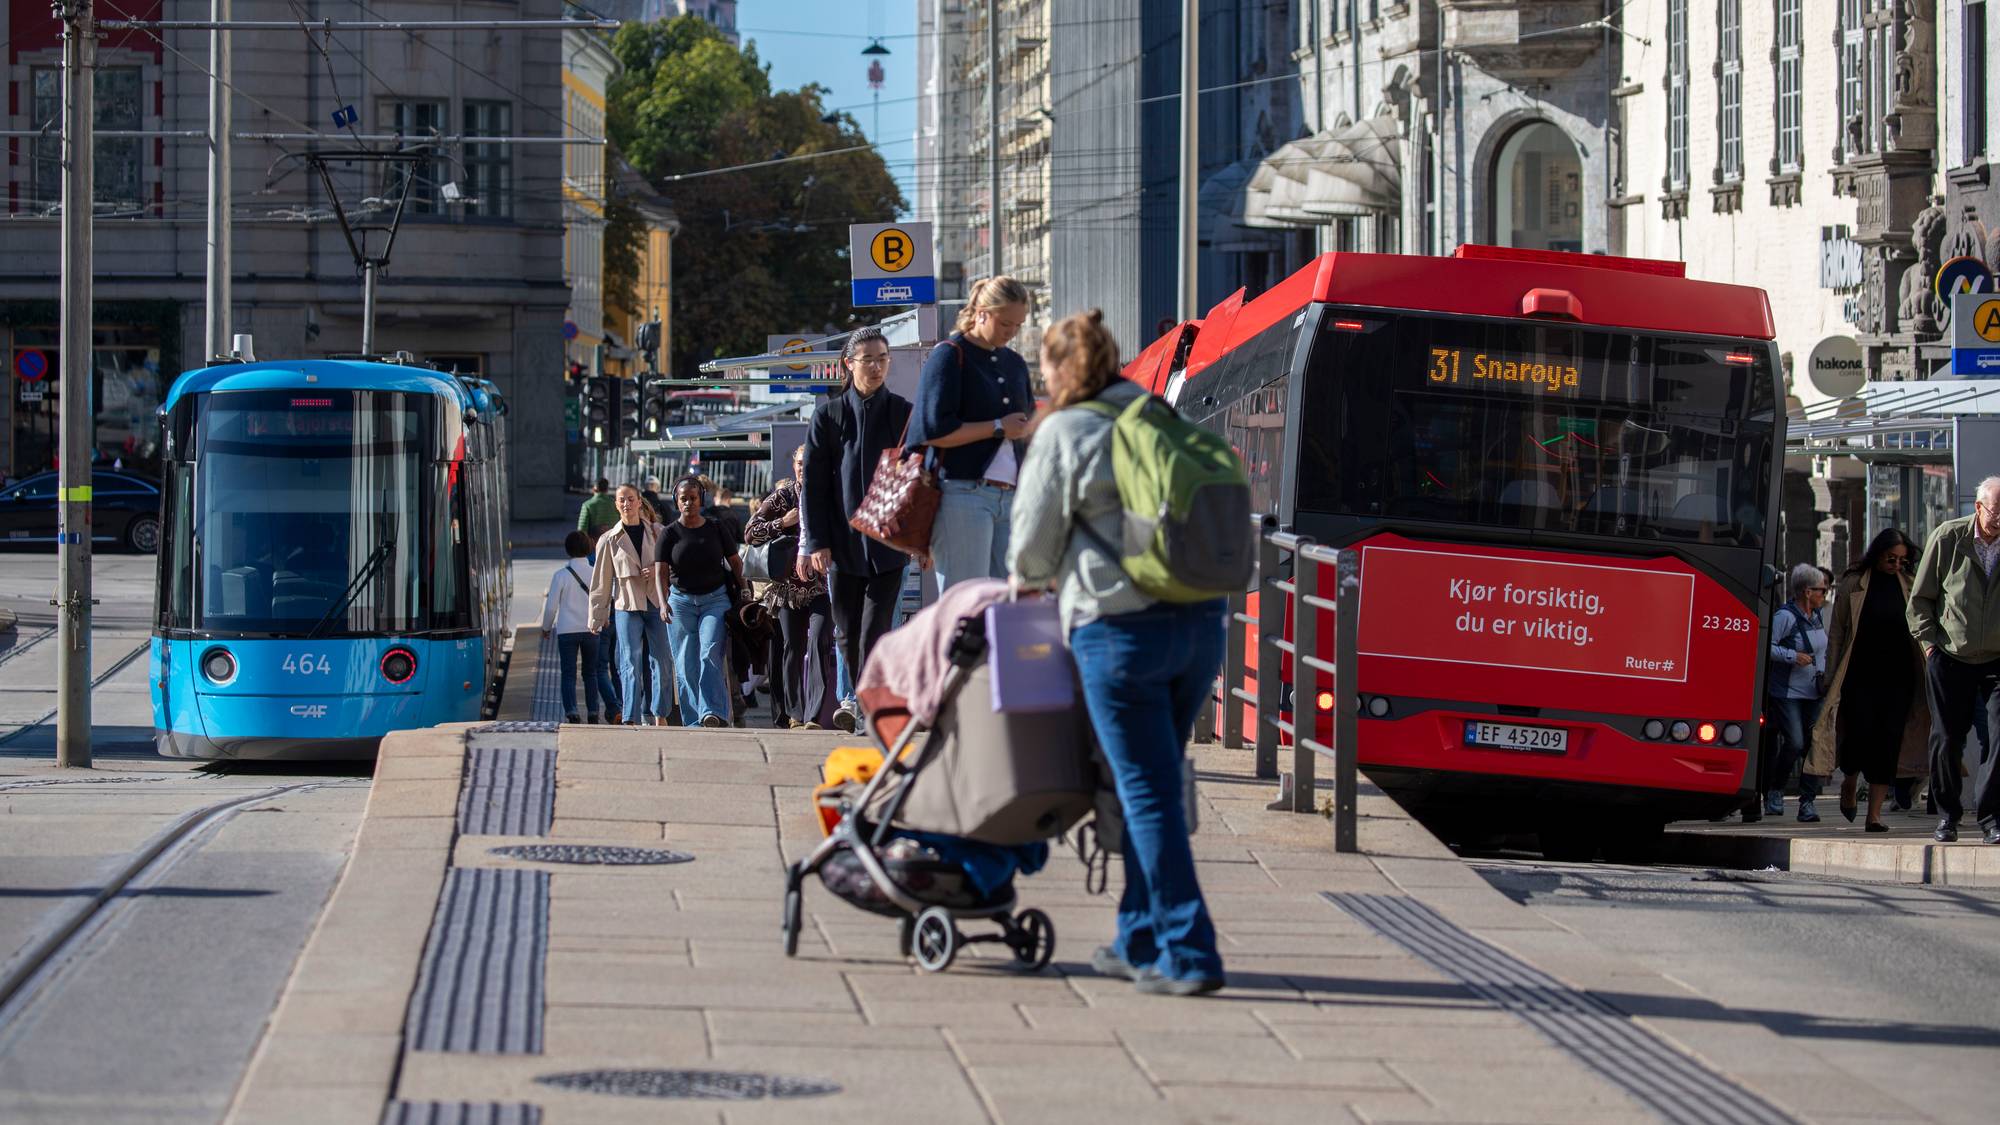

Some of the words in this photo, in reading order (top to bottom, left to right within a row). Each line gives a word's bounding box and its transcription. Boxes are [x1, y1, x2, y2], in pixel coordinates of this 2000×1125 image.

[883, 236, 904, 265] B
[1430, 348, 1460, 383] 31
[1473, 354, 1578, 391] Snarøya
[1815, 356, 1863, 370] hakone
[1449, 578, 1496, 604] Kjør
[1503, 583, 1605, 615] forsiktig,
[1455, 612, 1484, 632] du
[1492, 617, 1516, 635] er
[1523, 617, 1594, 646] viktig.
[1702, 615, 1720, 629] 23
[1723, 617, 1750, 632] 283
[282, 653, 331, 675] 464
[1625, 656, 1675, 671] Ruter#
[290, 705, 327, 718] CAF
[1481, 725, 1501, 742] EF
[1508, 728, 1562, 747] 45209
